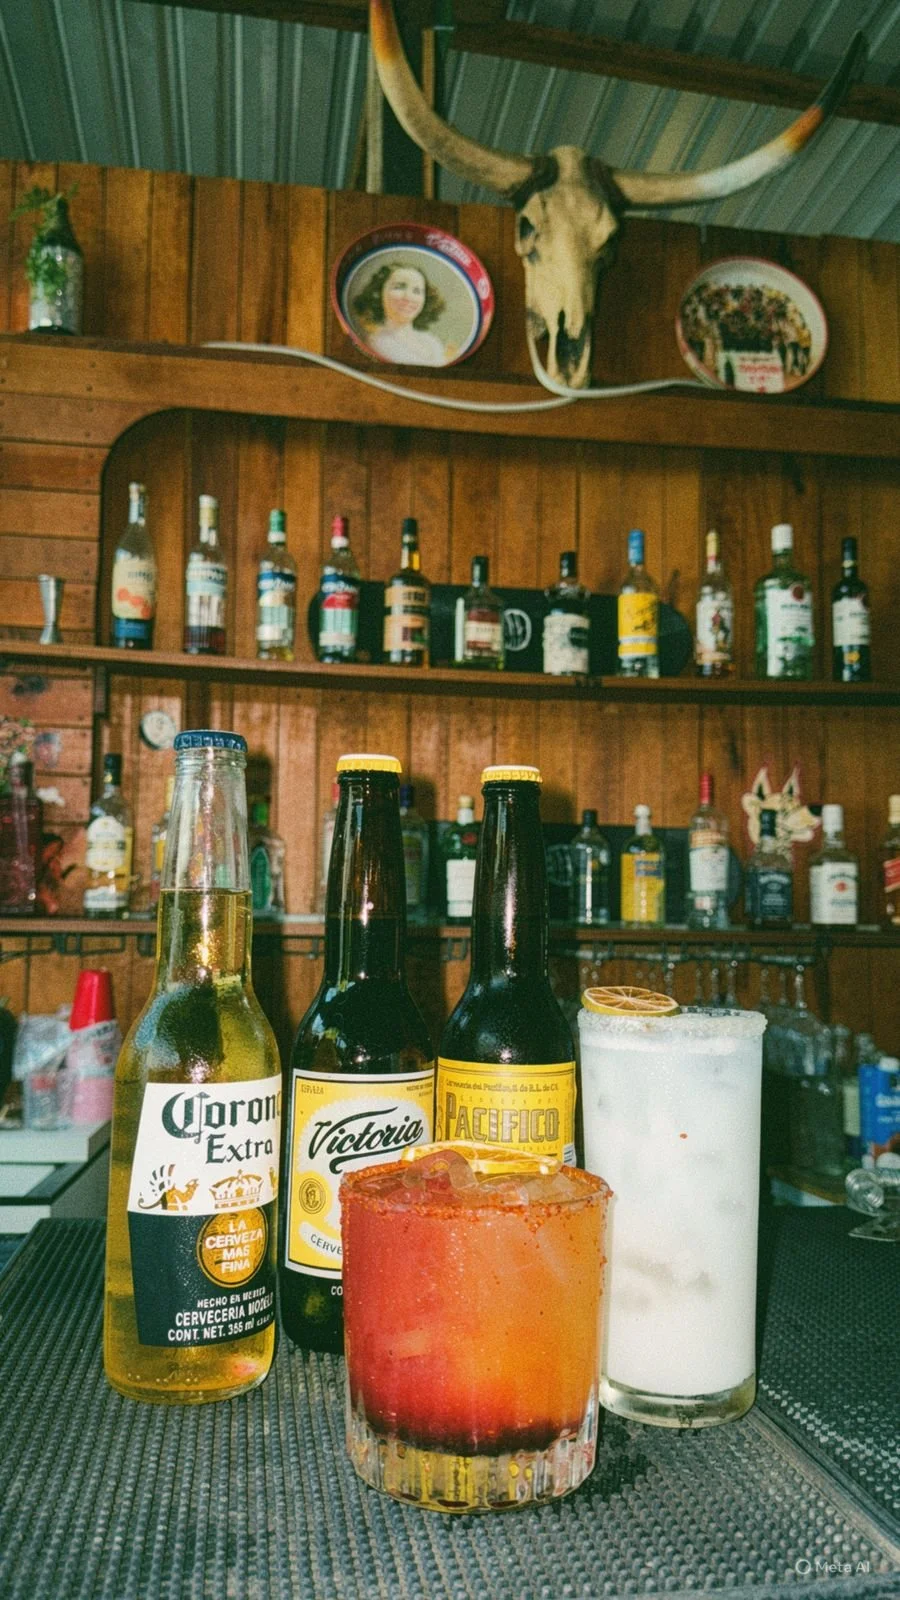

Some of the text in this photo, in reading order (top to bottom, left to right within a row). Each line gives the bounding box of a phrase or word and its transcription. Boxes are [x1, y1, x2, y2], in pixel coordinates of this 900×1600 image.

[445, 1091, 560, 1143] PACIFICO
[308, 1106, 424, 1160] Victoria
[205, 1132, 273, 1164] Extra
[229, 1219, 247, 1234] LA
[205, 1228, 263, 1249] CERVEZA
[222, 1244, 251, 1261] MAS
[221, 1258, 251, 1274] FINA
[197, 1296, 228, 1309] HECHO
[230, 1294, 241, 1305] EN
[175, 1307, 246, 1327] CERVECERIA
[167, 1328, 201, 1342] CONT.
[203, 1324, 226, 1340] NET.
[244, 1317, 255, 1331] ml
